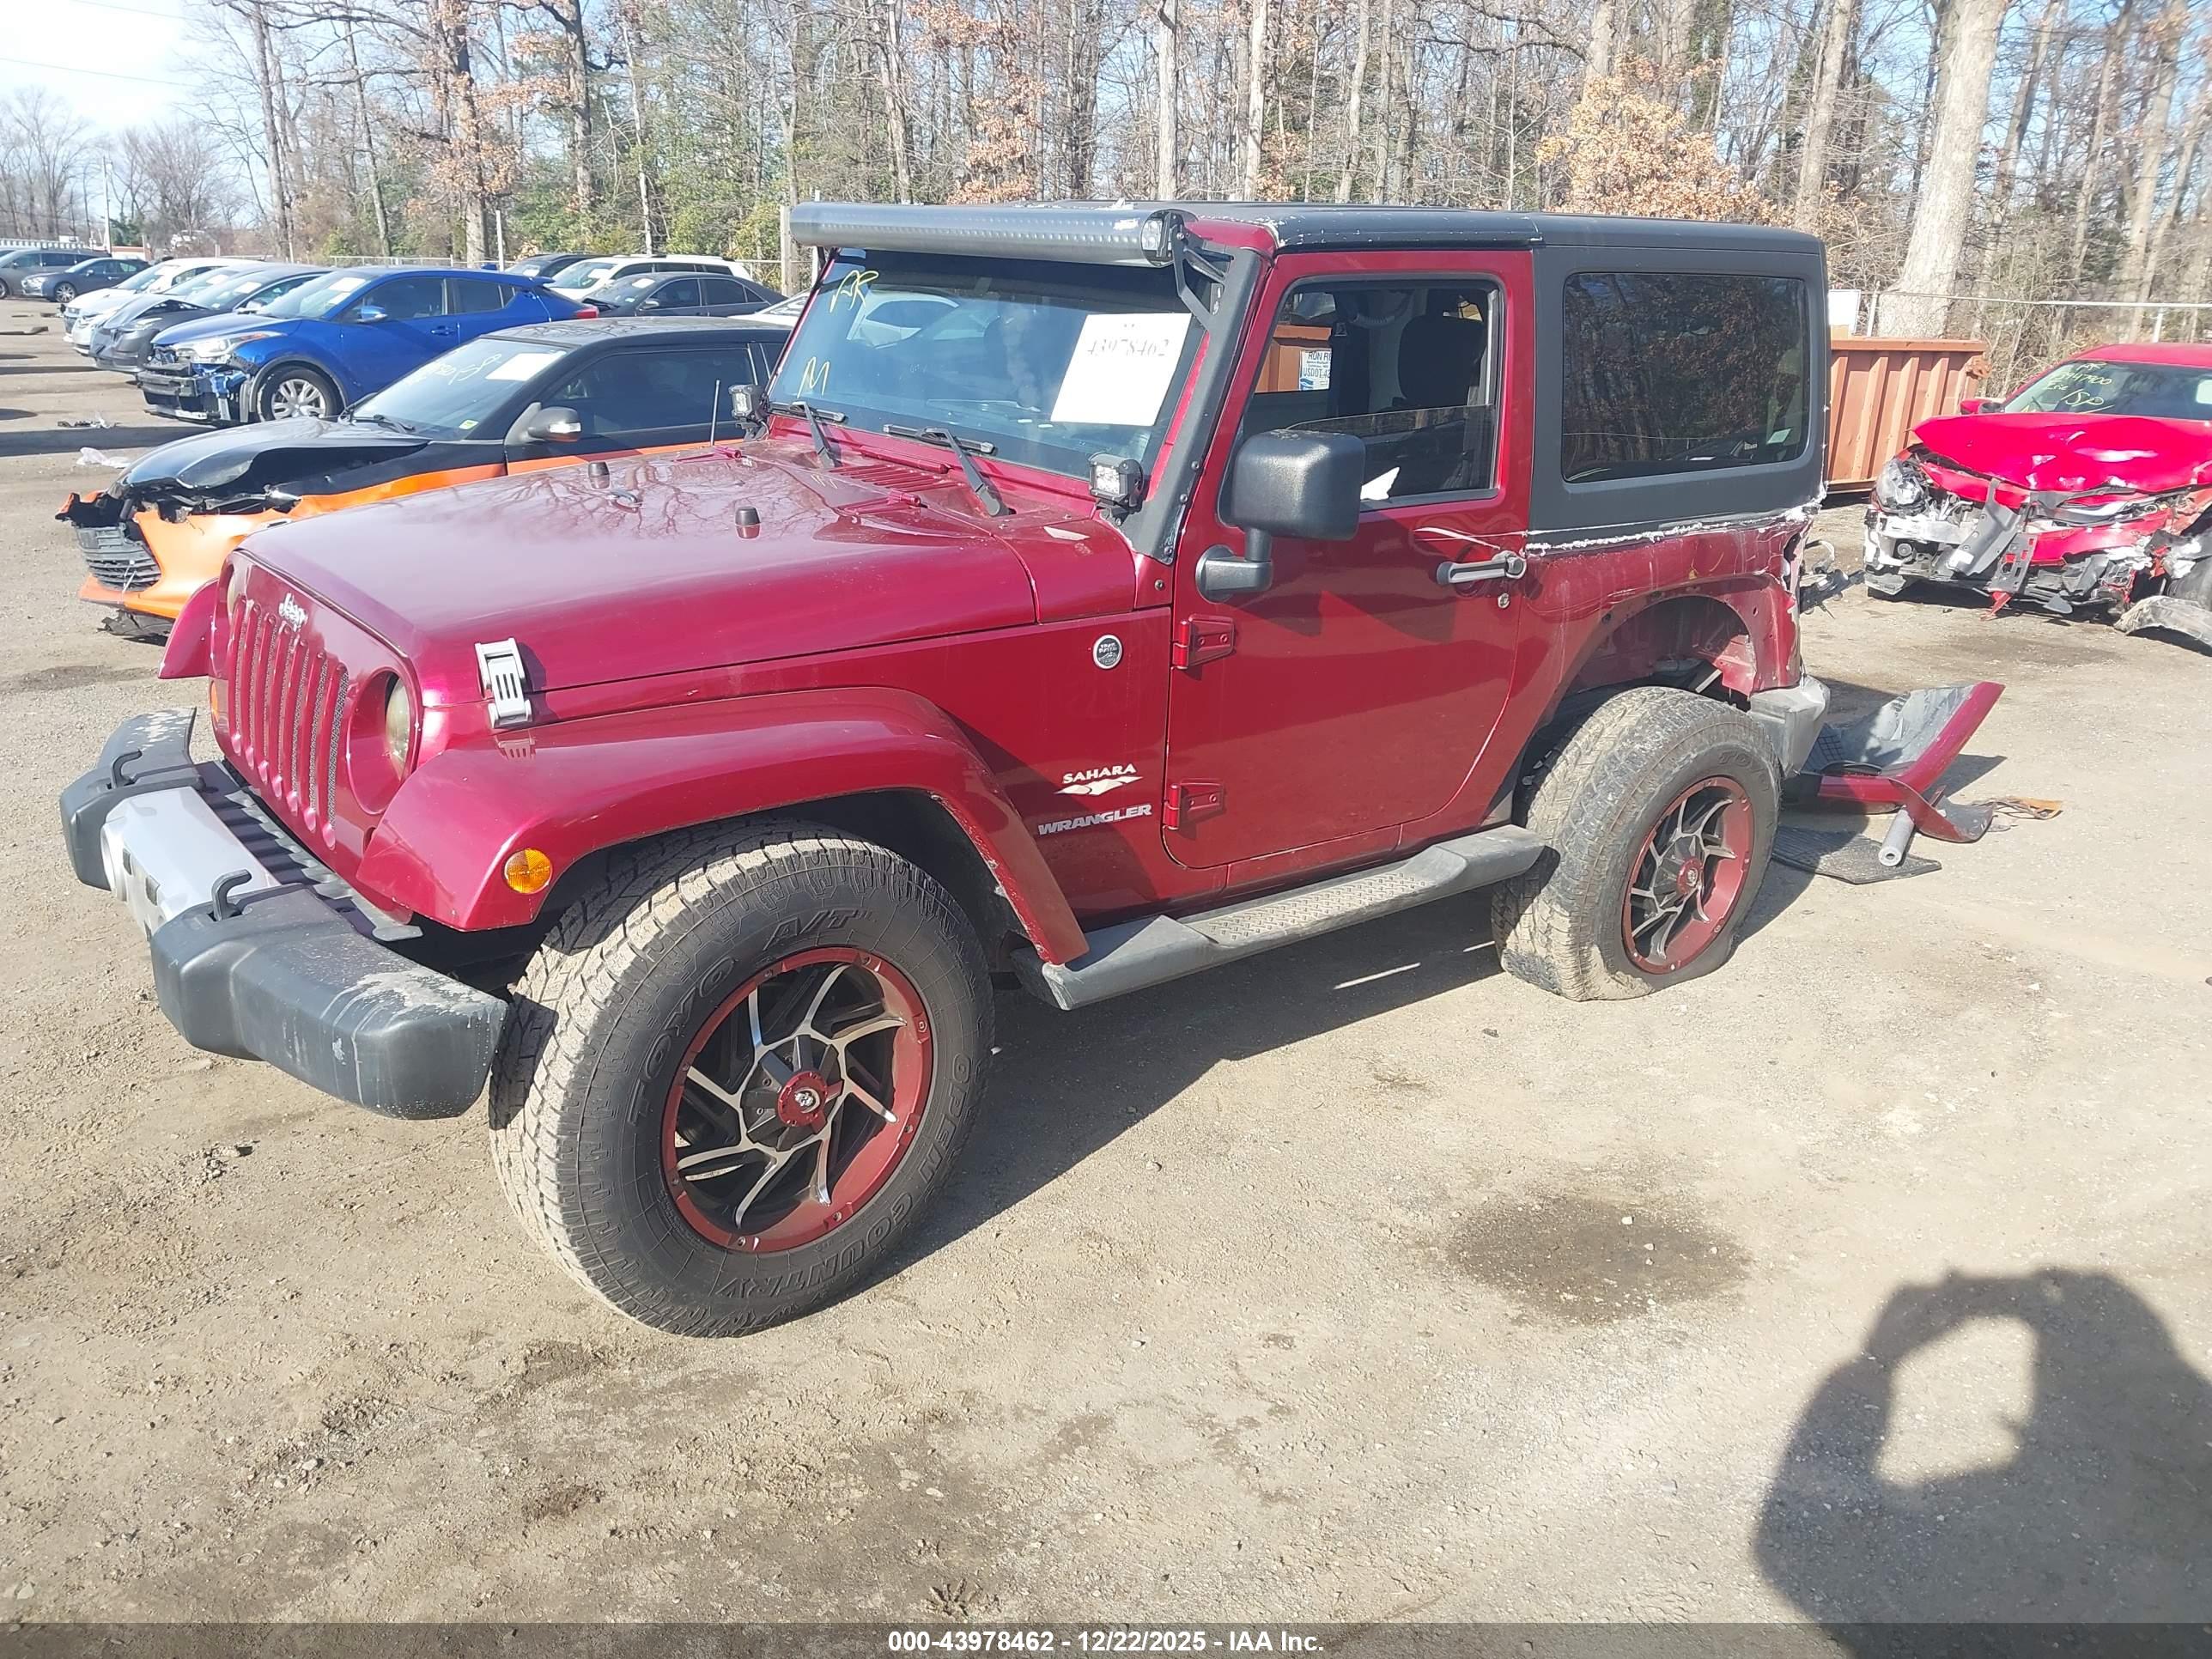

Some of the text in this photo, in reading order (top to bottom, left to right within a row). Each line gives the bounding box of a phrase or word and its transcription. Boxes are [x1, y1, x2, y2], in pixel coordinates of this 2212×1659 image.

[797, 356, 830, 398] M
[1303, 368, 1322, 378] USDOT
[1062, 763, 1136, 784] SAHARA
[1038, 804, 1152, 836] WRANGLER
[627, 957, 733, 1126] TOYO
[919, 1053, 972, 1184] OPEN
[714, 1192, 914, 1298] COUNTRY
